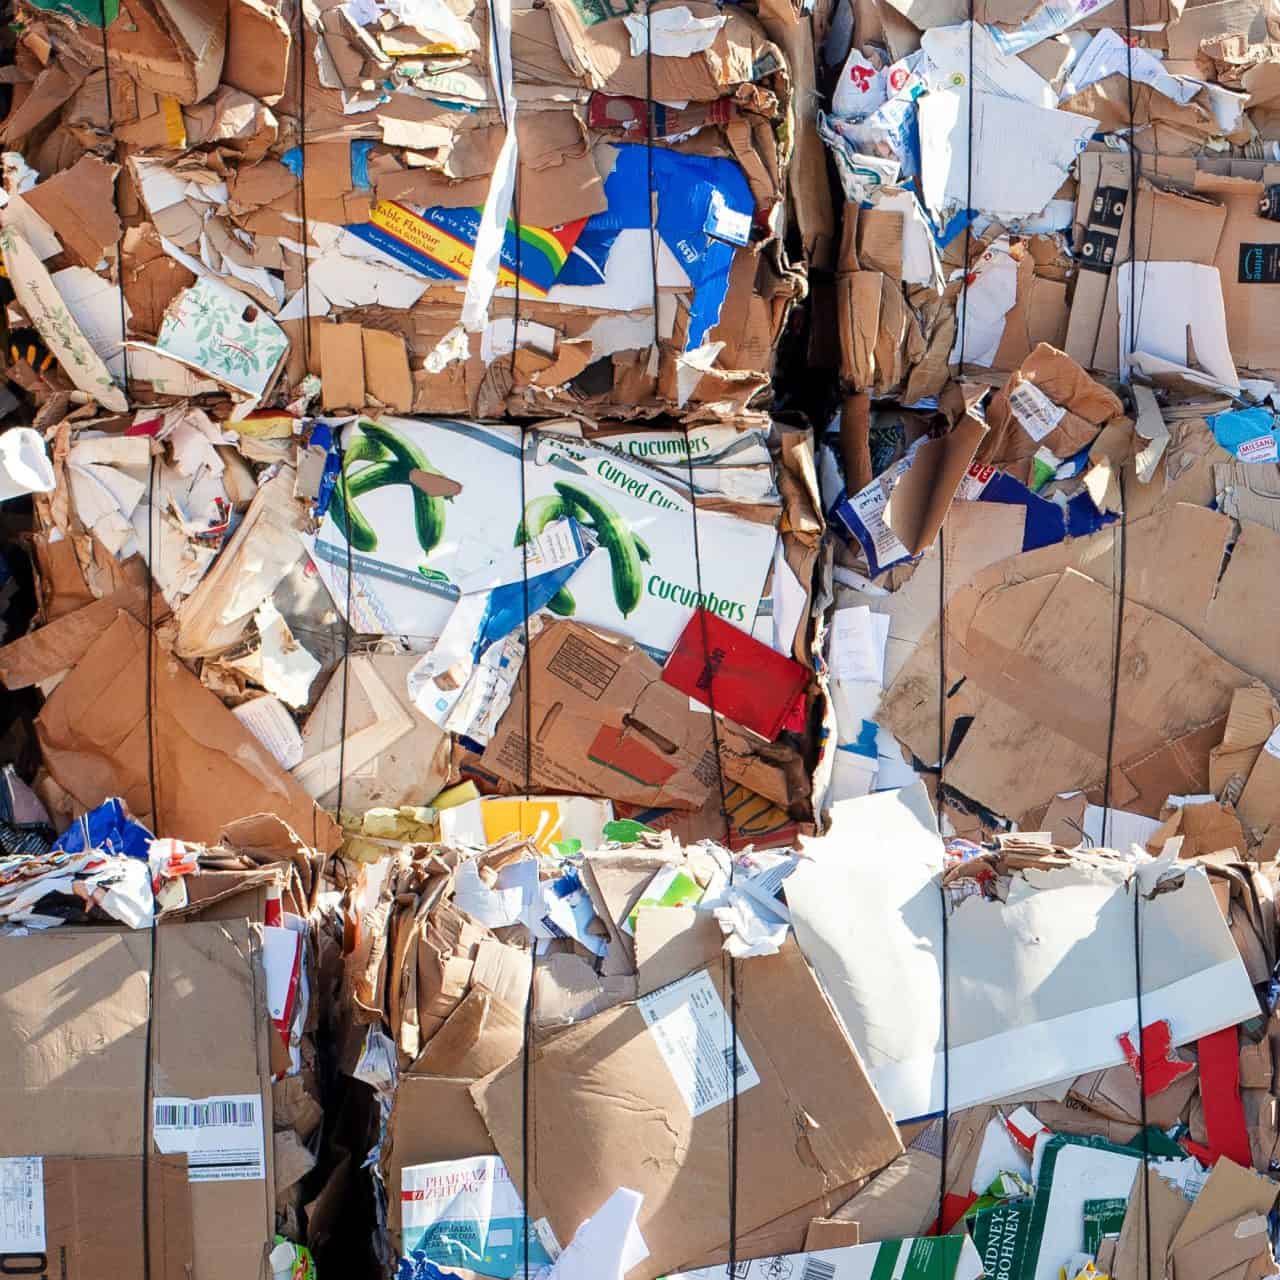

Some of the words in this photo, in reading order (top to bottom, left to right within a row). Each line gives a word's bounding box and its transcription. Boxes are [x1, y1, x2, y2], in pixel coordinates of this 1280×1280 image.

[403, 218, 441, 247] Flavour
[1252, 248, 1265, 280] prime
[597, 459, 649, 498] Curved
[647, 575, 747, 622] Cucumbers
